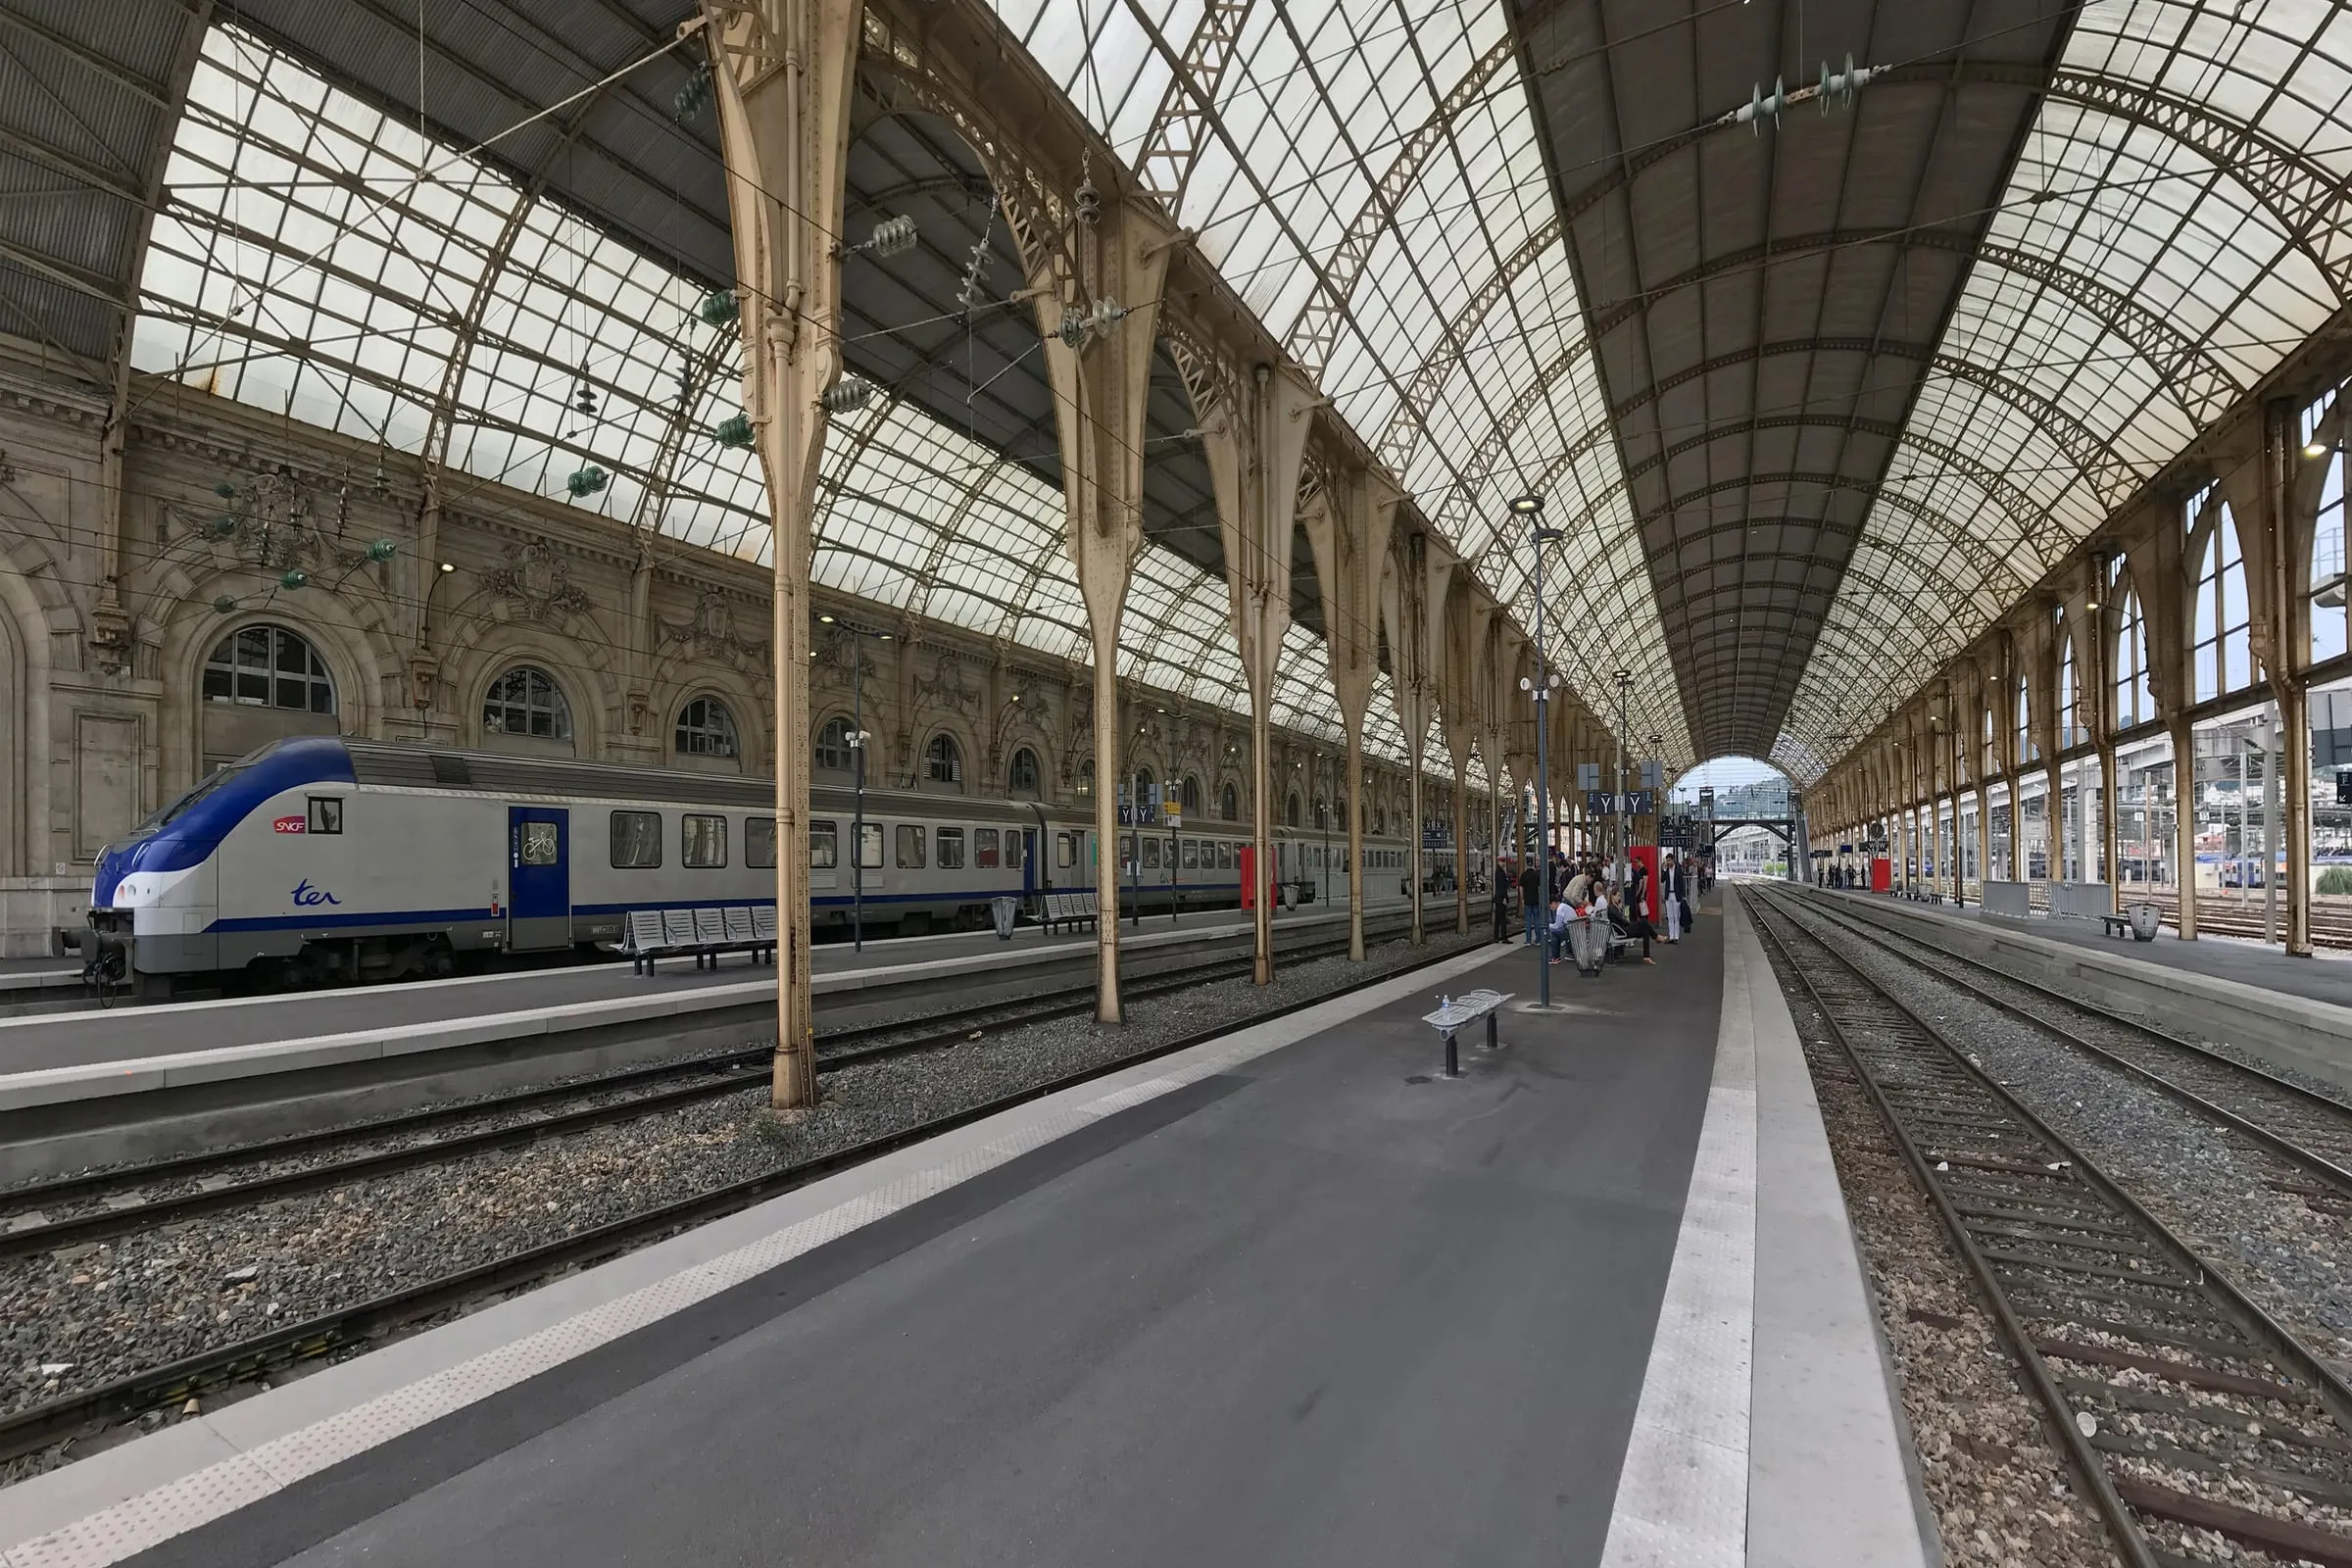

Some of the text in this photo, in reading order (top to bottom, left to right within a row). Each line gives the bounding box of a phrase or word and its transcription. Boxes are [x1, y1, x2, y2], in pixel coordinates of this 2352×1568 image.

[1600, 797, 1611, 813] Y
[1630, 796, 1640, 813] Y
[1122, 808, 1129, 822] Y
[1140, 808, 1147, 822] Y
[275, 821, 305, 832] SNCF
[290, 877, 342, 906] ter
